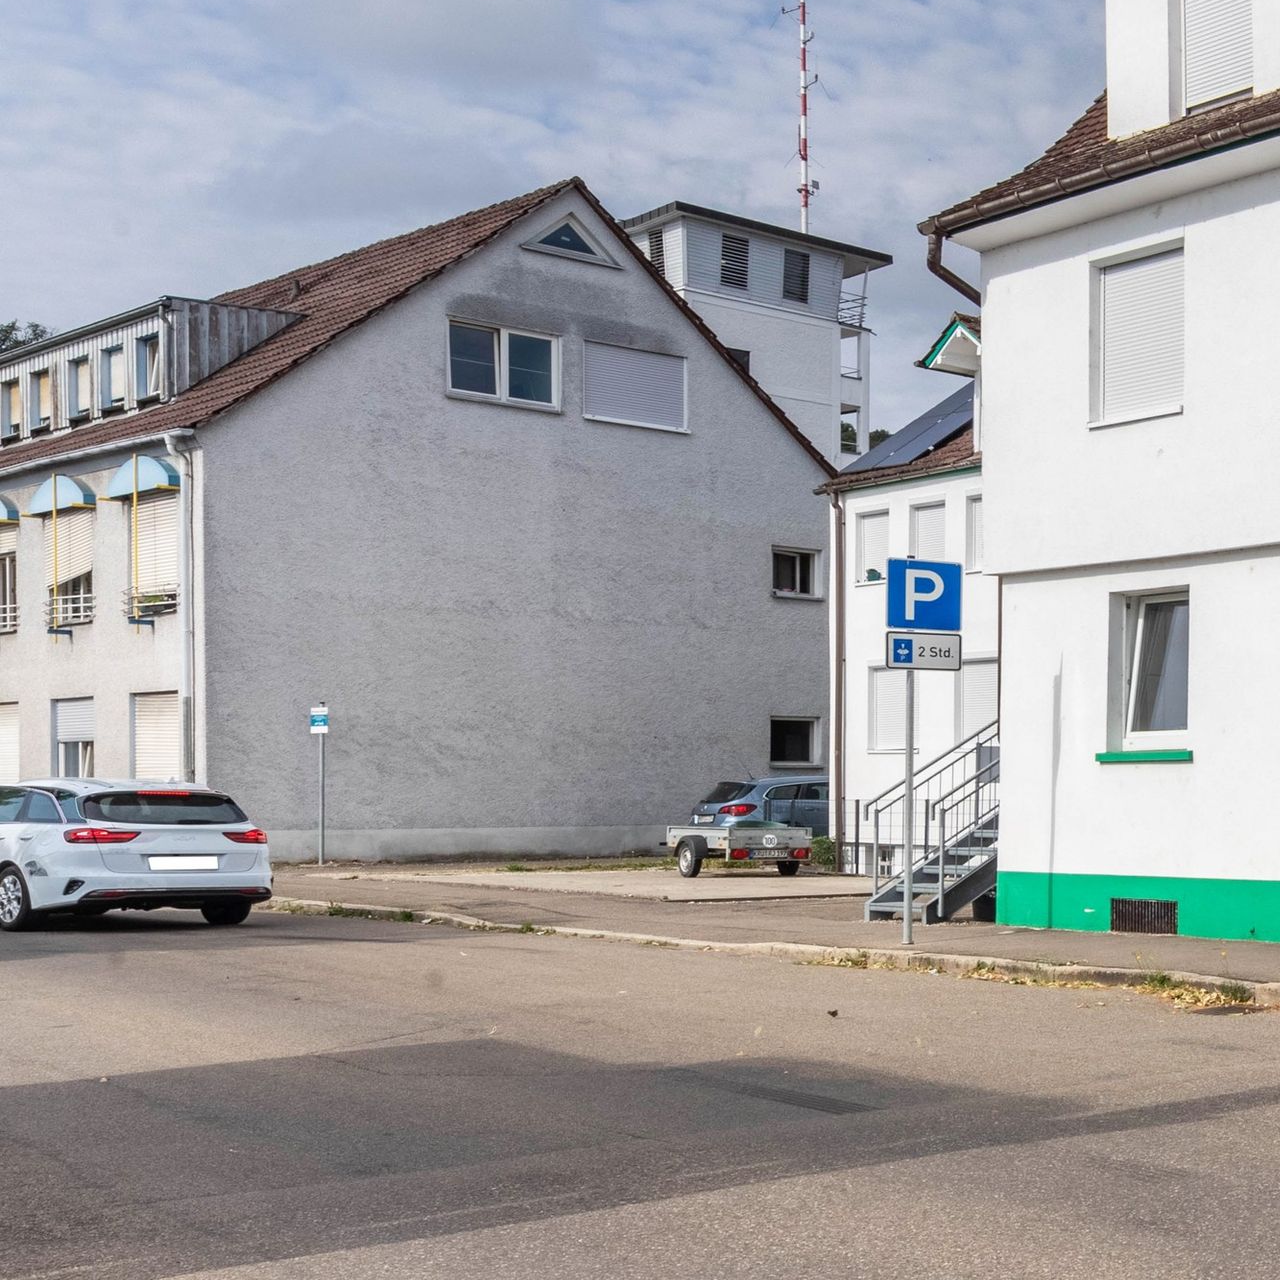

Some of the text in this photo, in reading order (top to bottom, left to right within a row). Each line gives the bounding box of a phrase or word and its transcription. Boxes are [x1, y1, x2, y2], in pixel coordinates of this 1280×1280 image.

[905, 568, 945, 621] P
[918, 646, 954, 658] 2 Std.
[764, 836, 776, 846] 100
